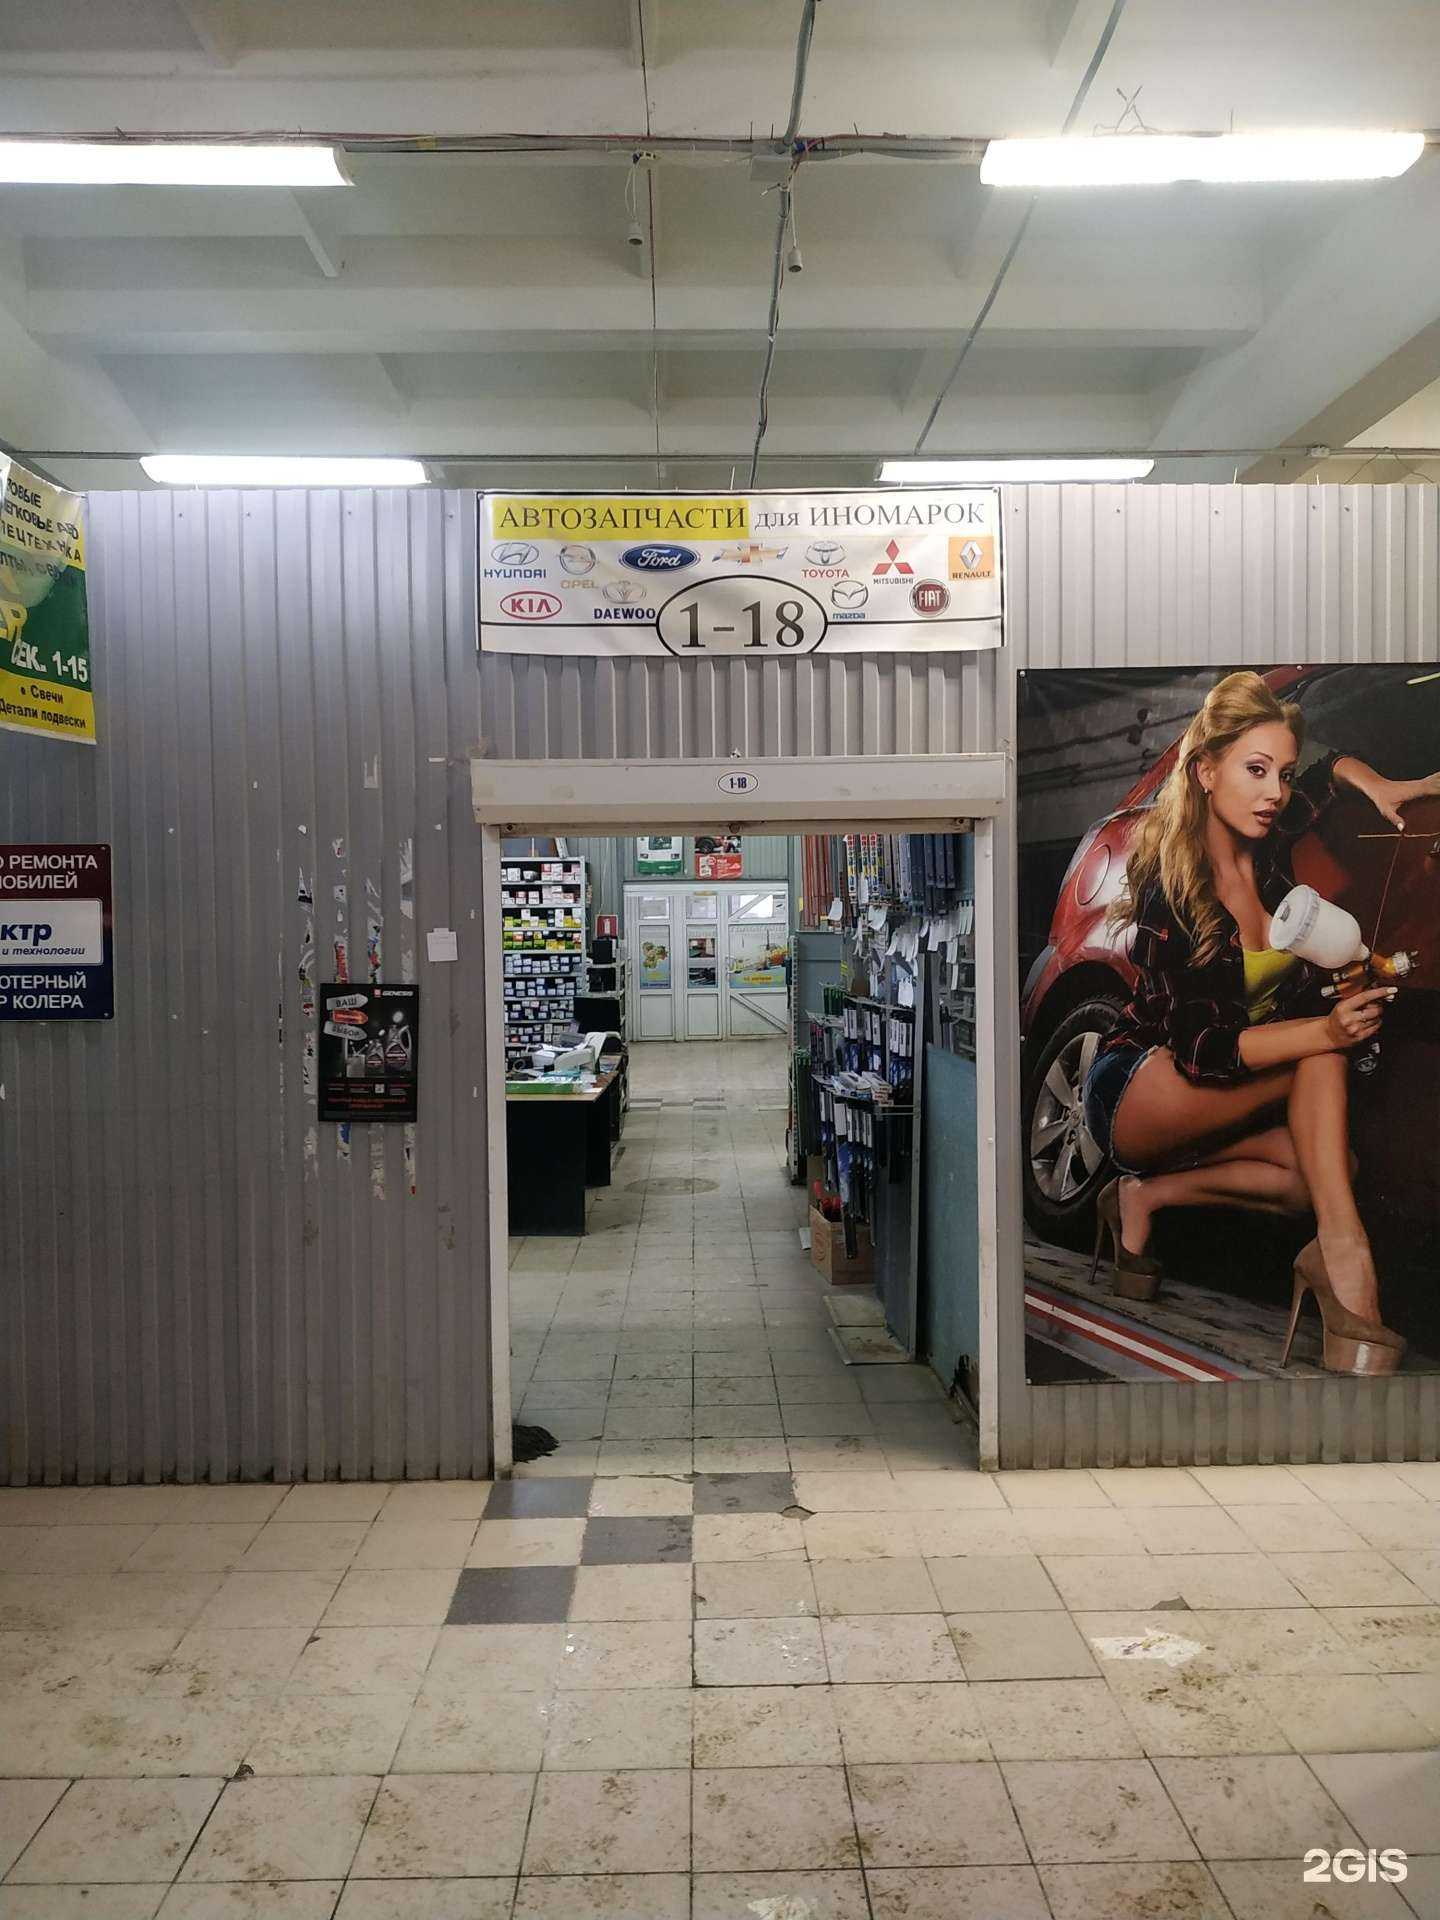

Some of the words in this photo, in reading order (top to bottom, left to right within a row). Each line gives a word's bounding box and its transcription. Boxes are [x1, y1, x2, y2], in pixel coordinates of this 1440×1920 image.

[500, 507, 745, 530] АВТОЗАПЧАСТИ
[755, 511, 799, 530] для
[809, 503, 985, 527] ИНОМАРОК
[637, 548, 681, 567] Ford
[484, 568, 547, 579] HYUNDAI
[801, 568, 850, 579] TOYOTA
[873, 577, 914, 585] MITSUBISHI
[952, 570, 992, 579] RENAULT
[560, 580, 598, 589] OPEL
[511, 598, 551, 613] KIA
[918, 590, 942, 607] FIAT
[593, 608, 656, 620] DAEWOO
[832, 612, 866, 620] mazda
[52, 651, 88, 683] 1-15
[30, 684, 64, 704] Свечи
[41, 710, 87, 729] подвески
[729, 777, 747, 789] 1-18
[9, 854, 98, 870] РЕМОНТА
[0, 871, 78, 889] ОБИЛЕЙ
[0, 924, 52, 946] ктр
[12, 947, 86, 956] технологии
[13, 994, 85, 1009] КОЛЕРА
